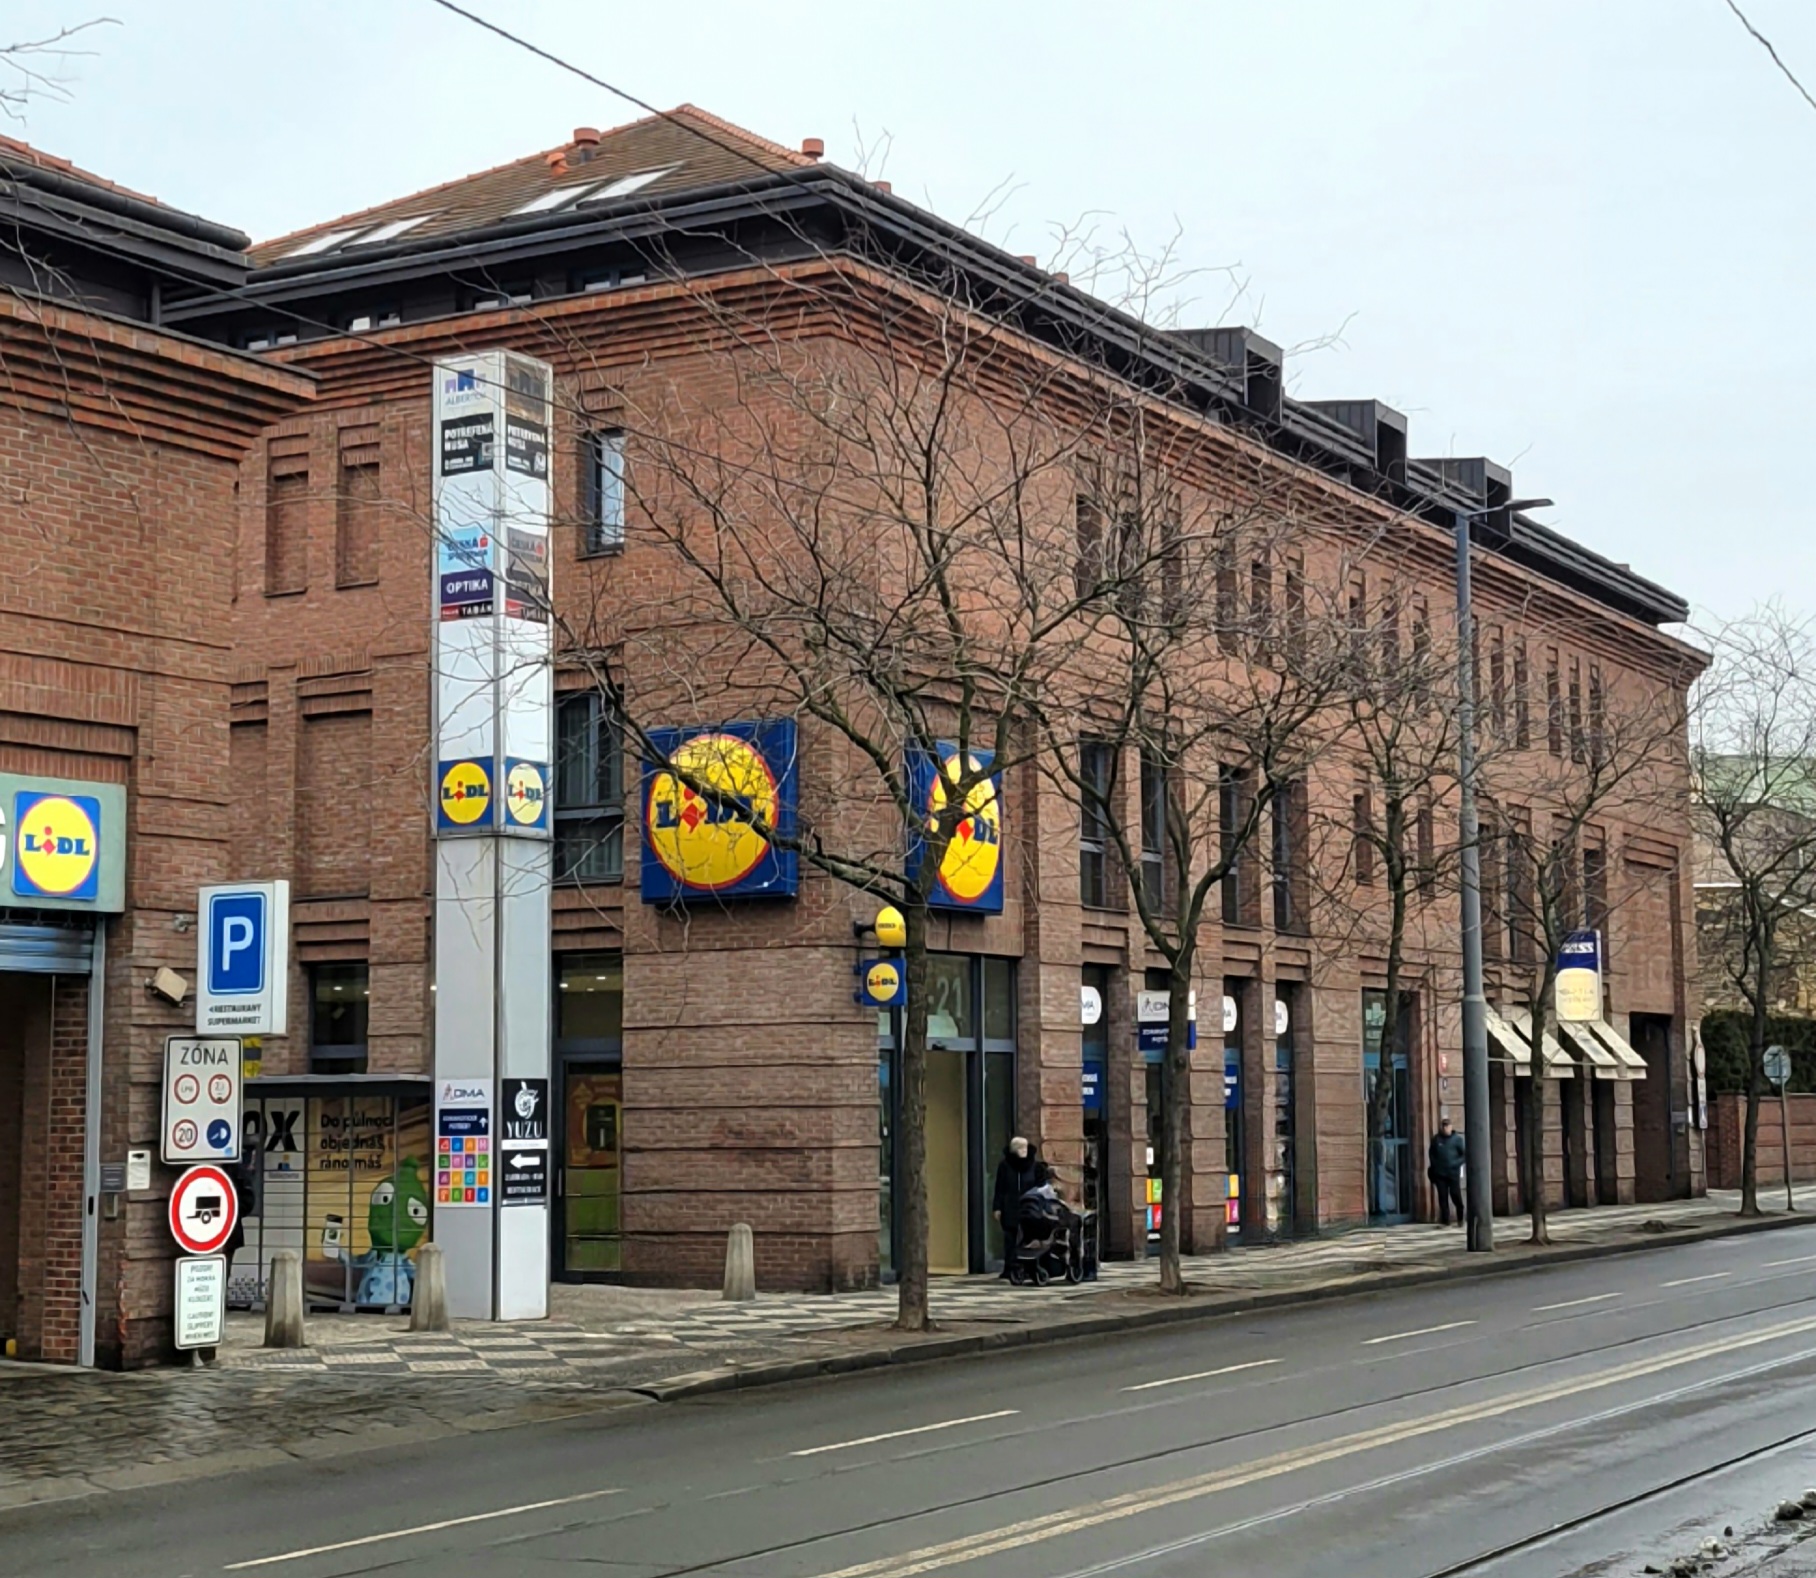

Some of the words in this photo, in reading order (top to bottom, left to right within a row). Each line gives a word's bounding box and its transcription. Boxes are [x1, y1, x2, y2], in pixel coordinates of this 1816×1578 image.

[446, 579, 488, 594] OPTIKA
[222, 916, 254, 971] P
[180, 1043, 229, 1066] ZÓNA
[321, 1114, 340, 1128] Do
[506, 1120, 542, 1138] YUZU
[179, 1127, 193, 1143] 20
[320, 1154, 349, 1169] ráno
[354, 1154, 382, 1169] máš
